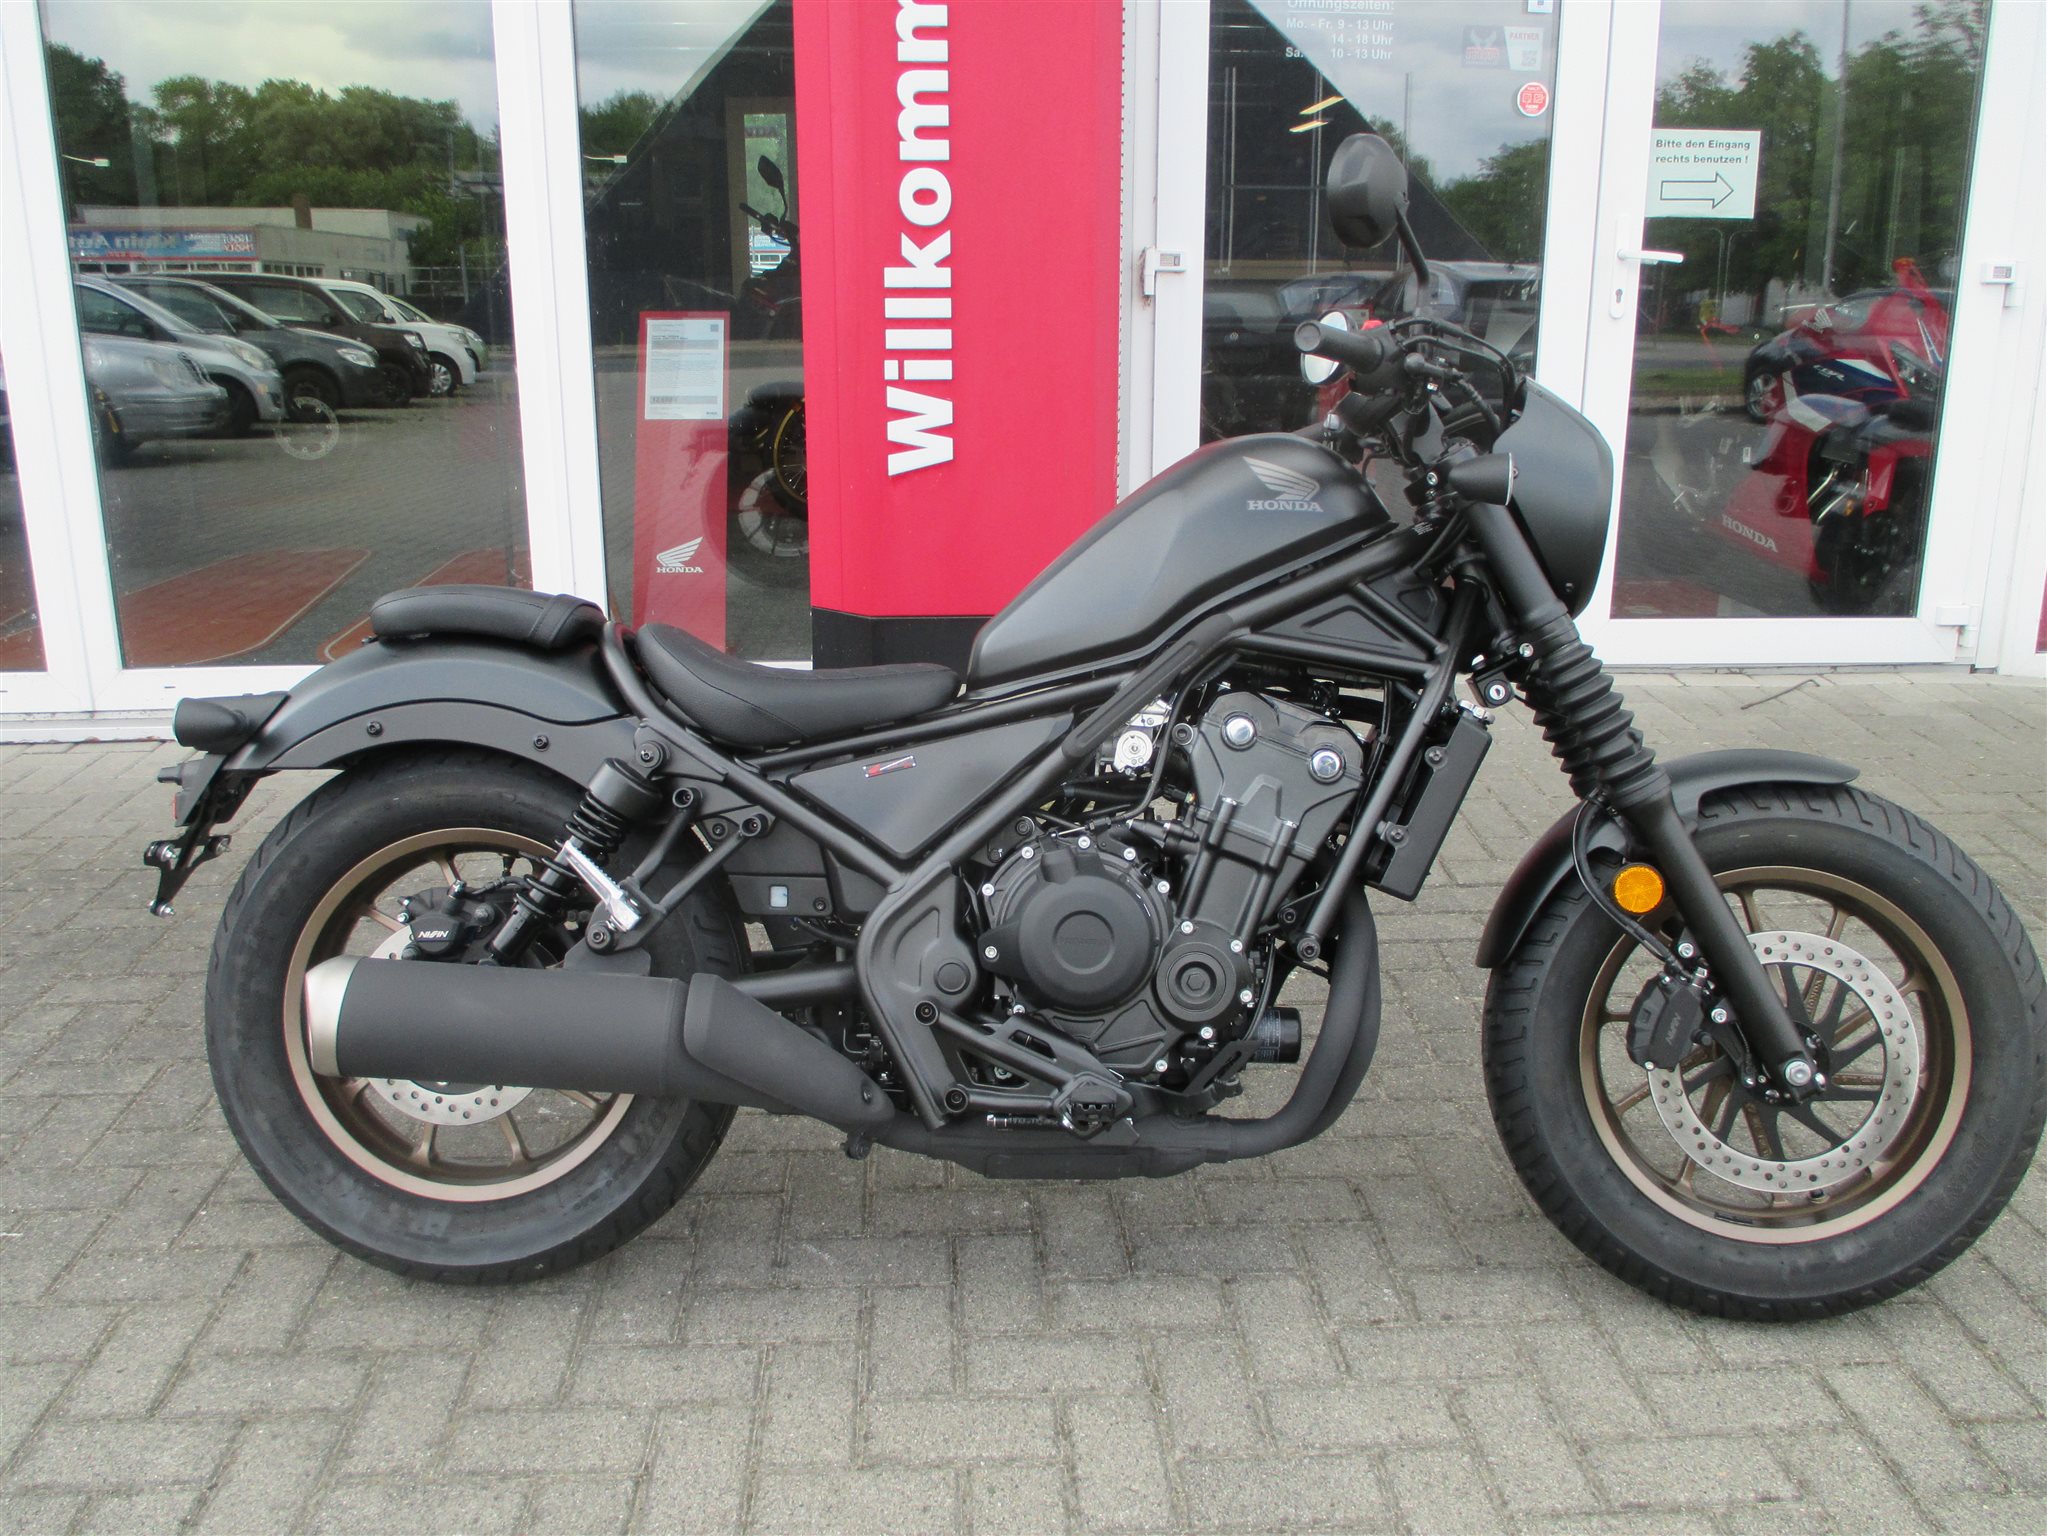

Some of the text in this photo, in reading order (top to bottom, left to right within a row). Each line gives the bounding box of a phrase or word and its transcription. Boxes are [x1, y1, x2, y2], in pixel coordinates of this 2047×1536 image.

[1286, 18, 1307, 29] Mo.
[1318, 19, 1333, 30] Fr.
[1338, 19, 1345, 30] 9
[1357, 20, 1369, 30] 13
[1373, 20, 1394, 31] Uhr
[1332, 34, 1344, 44] 14
[1357, 35, 1368, 44] 18
[1372, 35, 1393, 45] Uhr
[1285, 46, 1304, 58] Sa.
[1332, 48, 1344, 58] 10
[1356, 49, 1368, 59] 13
[1372, 49, 1393, 60] Uhr
[1656, 139, 1751, 151] Bitte den Eingang
[1655, 155, 1690, 163] rechts
[1693, 155, 1742, 164] benutzen
[1247, 500, 1324, 512] HONDA
[1722, 513, 1778, 553] HONDA
